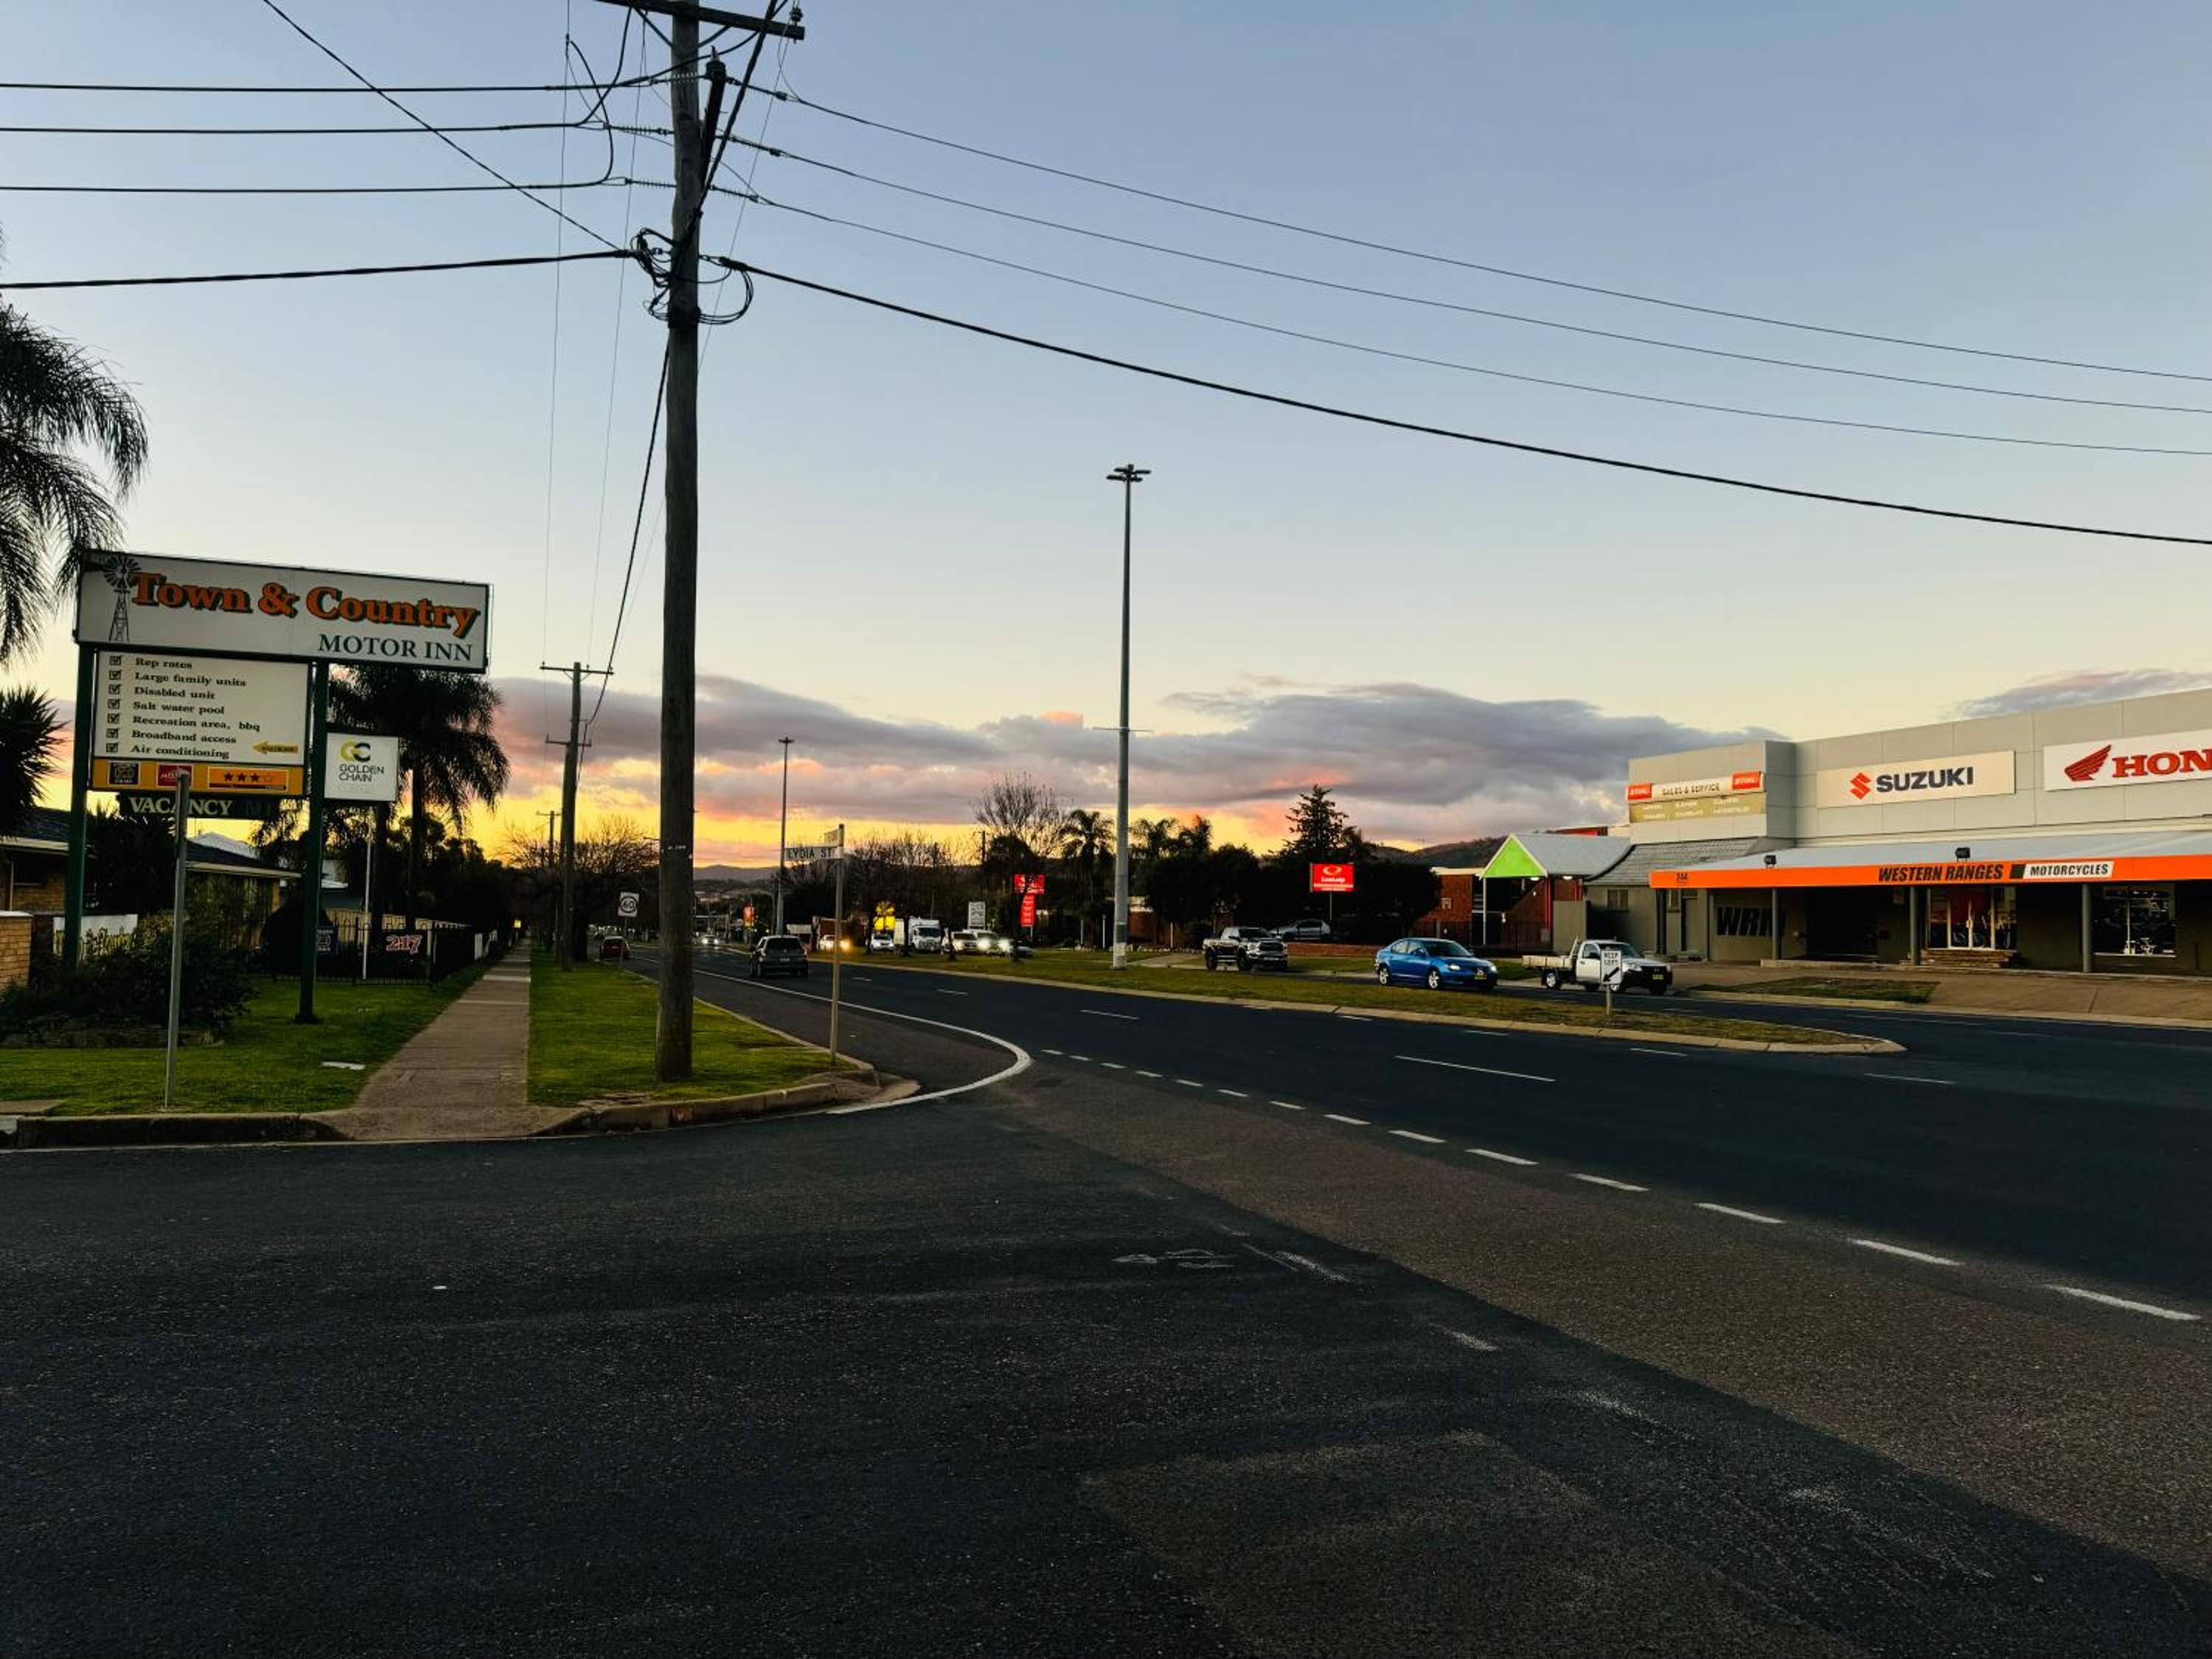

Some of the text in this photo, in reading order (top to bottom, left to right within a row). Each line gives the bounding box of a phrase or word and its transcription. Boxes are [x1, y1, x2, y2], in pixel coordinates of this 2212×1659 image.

[131, 571, 481, 639] Town & Country
[319, 633, 472, 661] MOTOR INN
[135, 657, 192, 669] Rep rates
[135, 672, 246, 686] Large family units
[134, 686, 215, 700] Disabled unit
[133, 700, 224, 715] Salt water pool
[133, 715, 196, 727] Recreation
[239, 721, 260, 732] bbq
[131, 729, 237, 744] Broadband access
[130, 745, 229, 759] Air conditioning
[339, 764, 384, 774] GOLDEN
[2111, 748, 2212, 778] HON
[339, 773, 372, 782] CHAIN
[1877, 766, 1974, 792] SUZUKI
[1663, 787, 1682, 796] SALES
[1691, 782, 1720, 793] SERVICE
[129, 797, 234, 815] VACNCY
[786, 848, 832, 859] LYDIA ST
[1878, 863, 2109, 882] WESTERN RANGES MOTORCYCLES
[623, 900, 635, 909] 60
